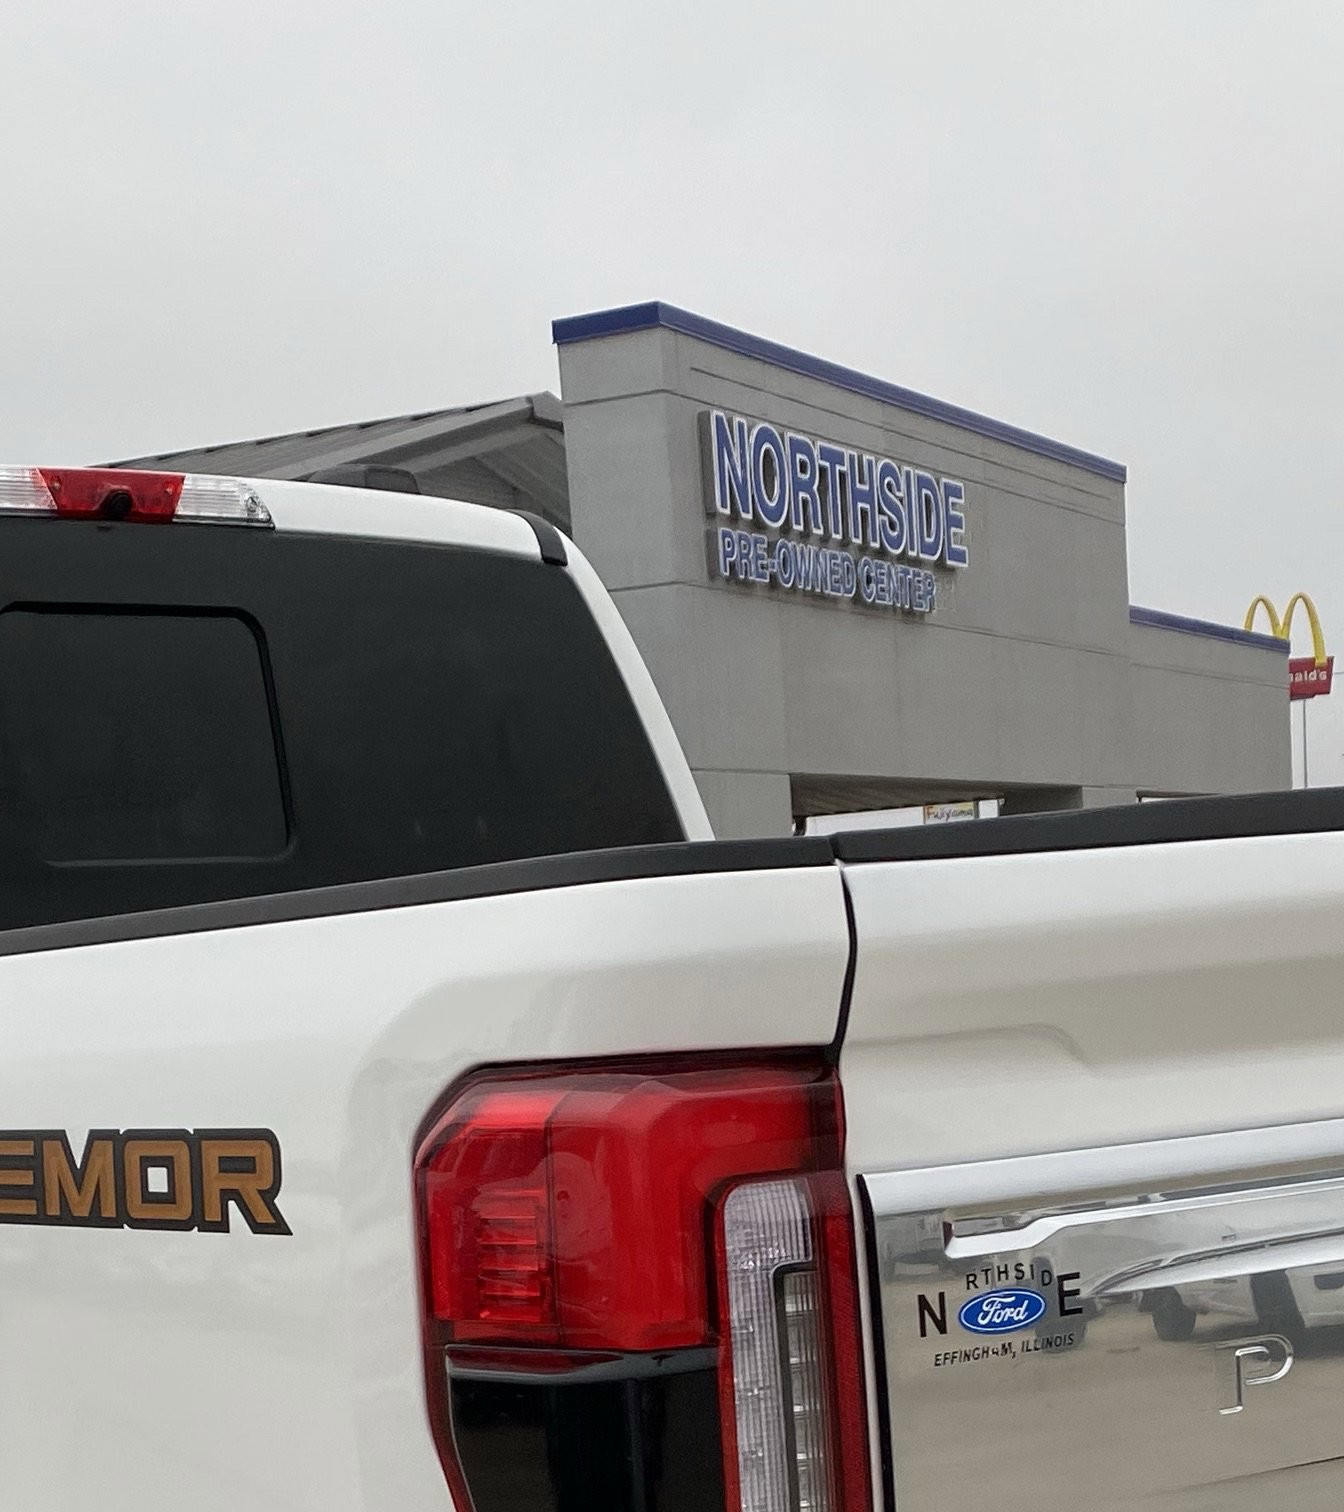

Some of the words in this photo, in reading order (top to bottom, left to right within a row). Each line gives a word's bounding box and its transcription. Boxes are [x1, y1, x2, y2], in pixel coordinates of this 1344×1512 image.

[710, 409, 969, 567] NORTHSIDE
[718, 527, 857, 598] PRE-OWNED
[858, 555, 937, 613] CENTER
[977, 1296, 1029, 1325] Ford
[1021, 1333, 1075, 1354] ILLINOIS
